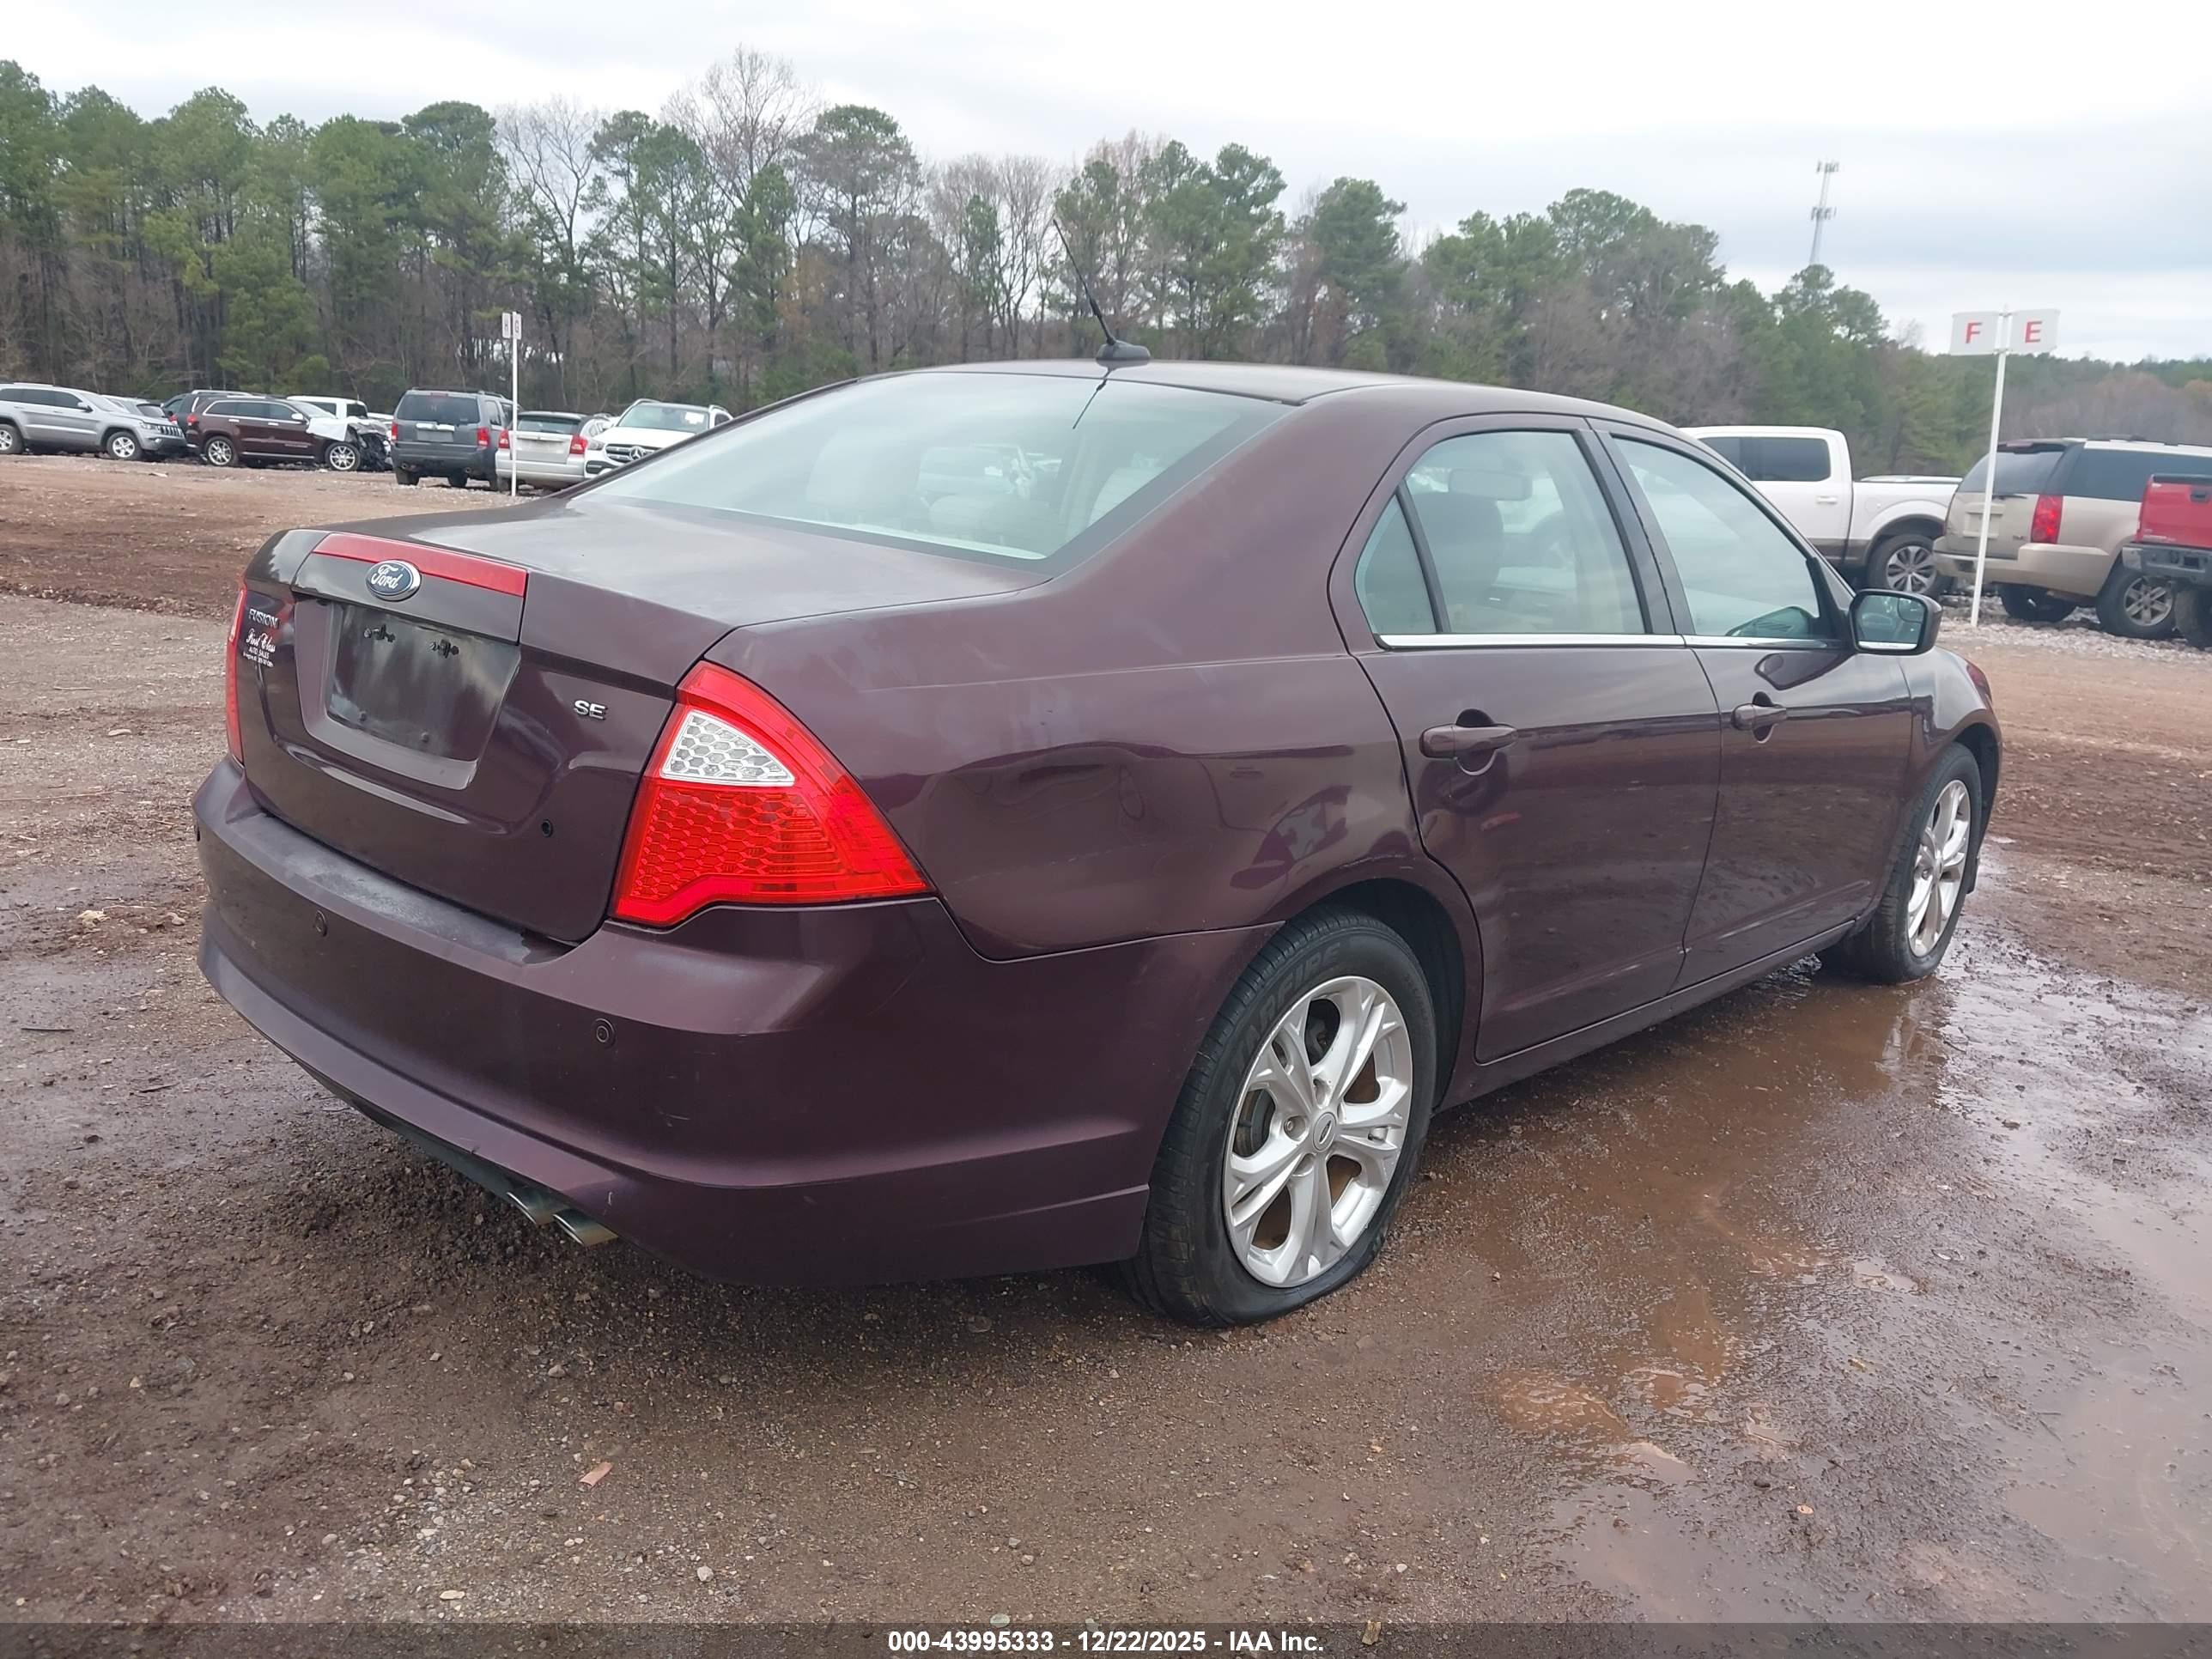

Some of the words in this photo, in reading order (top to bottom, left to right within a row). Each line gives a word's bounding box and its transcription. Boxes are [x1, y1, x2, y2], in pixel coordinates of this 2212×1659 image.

[1965, 322, 1983, 344] F
[2025, 320, 2043, 343] E
[371, 564, 404, 589] Ford
[248, 608, 280, 629] FUSION
[574, 700, 606, 720] SE
